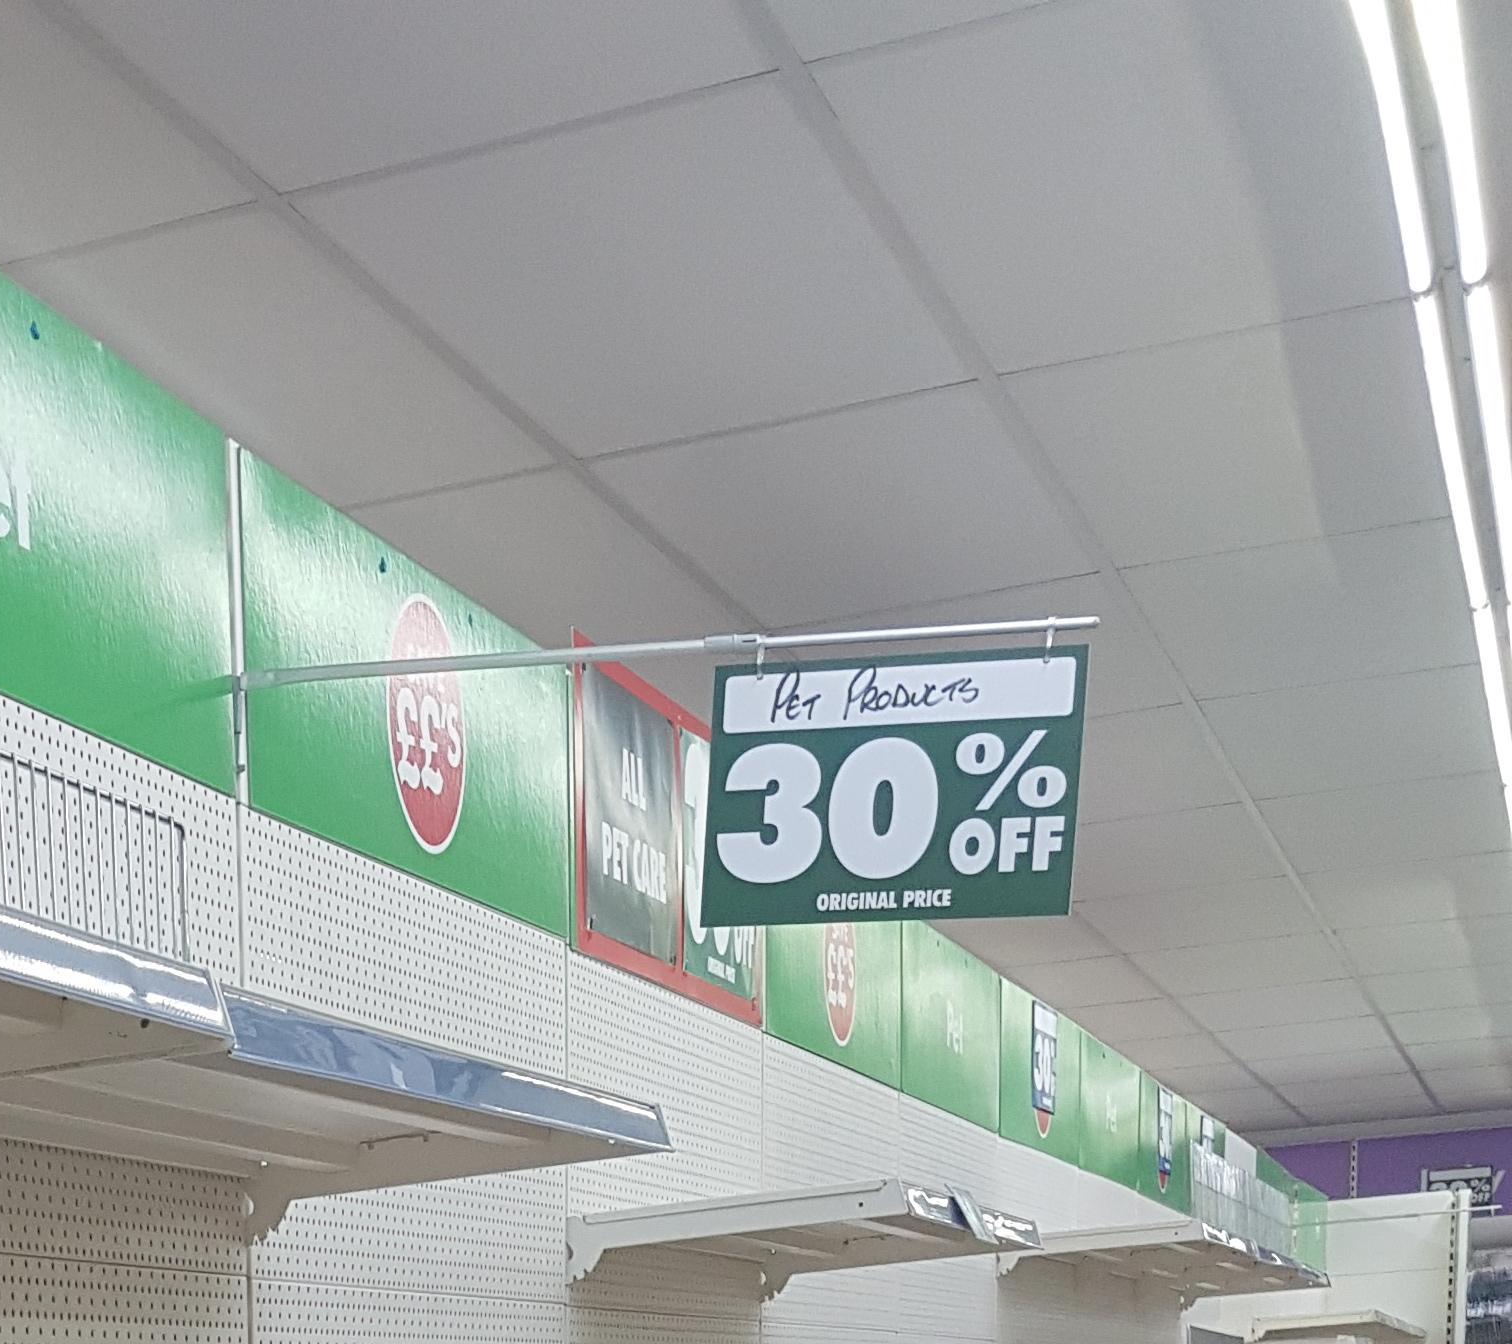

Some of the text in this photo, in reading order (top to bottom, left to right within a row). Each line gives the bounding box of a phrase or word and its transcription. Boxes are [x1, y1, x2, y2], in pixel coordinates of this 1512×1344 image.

[621, 747, 646, 812] ALL
[601, 820, 667, 904] PET CARE
[948, 815, 1066, 876] OFF
[816, 888, 953, 912] ORIGINAL PRICE
